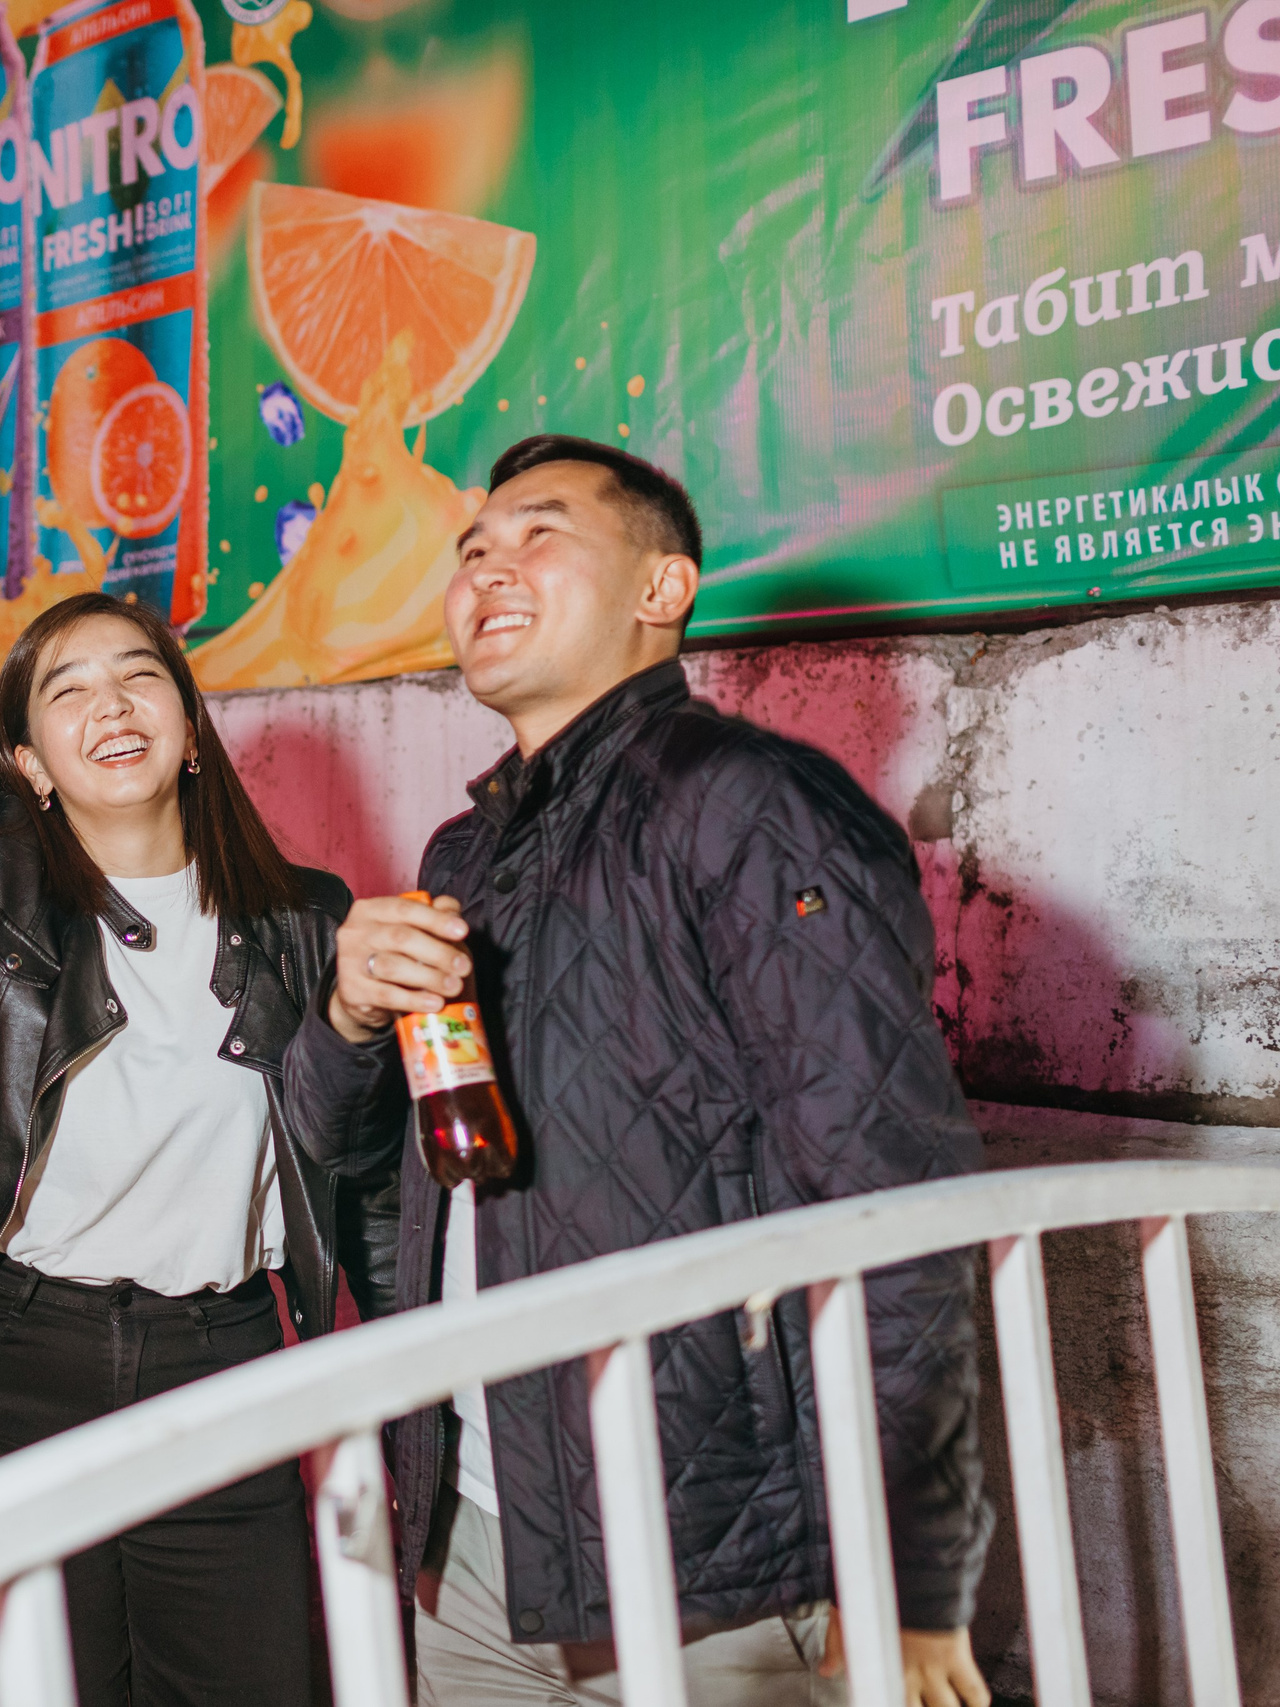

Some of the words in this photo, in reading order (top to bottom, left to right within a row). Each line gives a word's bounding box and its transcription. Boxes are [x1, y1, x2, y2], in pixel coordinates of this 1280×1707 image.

[937, 0, 1280, 200] FRES
[29, 83, 200, 217] NITRO
[43, 203, 144, 272] FRESH!
[932, 250, 1209, 357] Табит
[996, 473, 1264, 532] ЭНЕРГЕТИКАЛЫК
[999, 539, 1039, 569] НЕ
[1055, 517, 1230, 563] ЯВЛЯЕТСЯ
